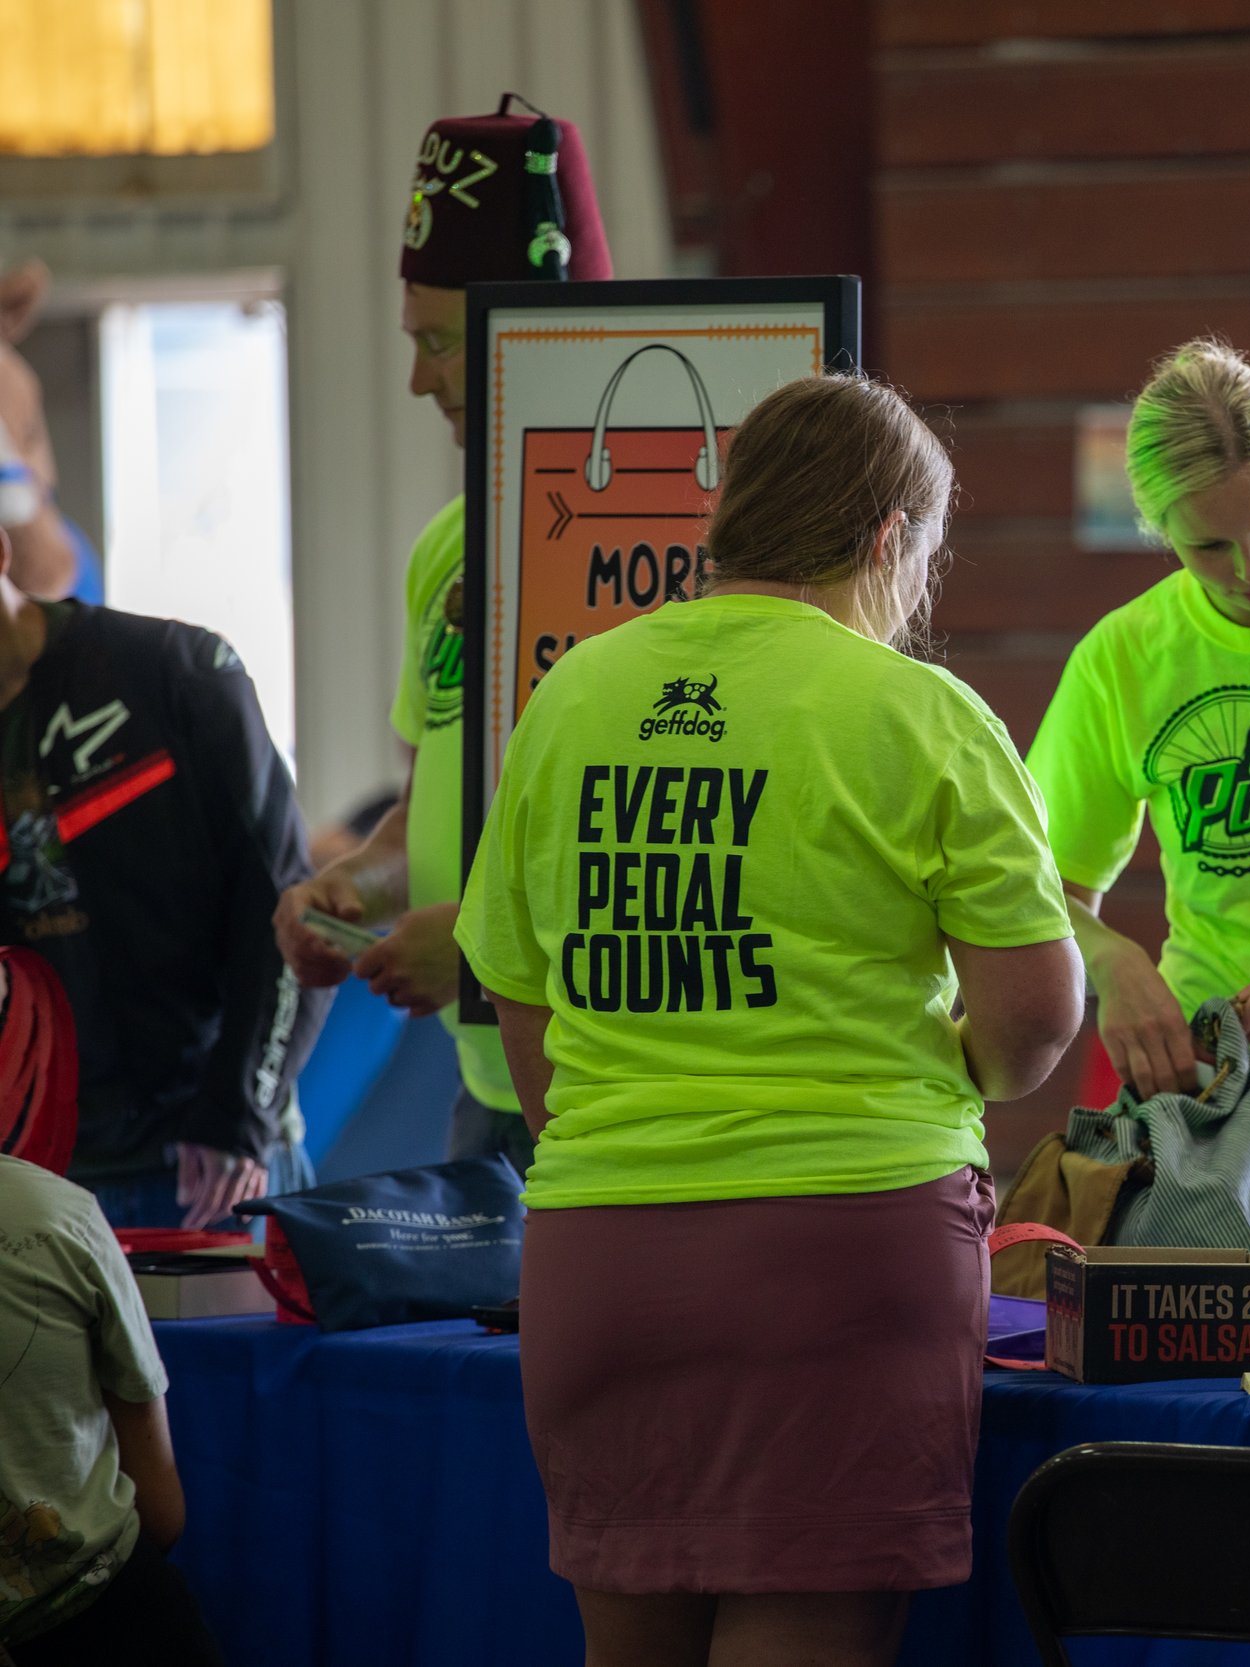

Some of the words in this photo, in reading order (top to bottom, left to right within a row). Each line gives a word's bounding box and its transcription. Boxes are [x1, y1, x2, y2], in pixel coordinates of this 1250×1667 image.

[638, 709, 726, 743] geffdog
[577, 764, 769, 847] EVERY
[577, 851, 754, 932] PEDAL
[561, 932, 778, 1013] COUNTS
[1111, 1284, 1138, 1319] IT
[1143, 1284, 1235, 1320] TAKES
[1107, 1323, 1148, 1362] TO
